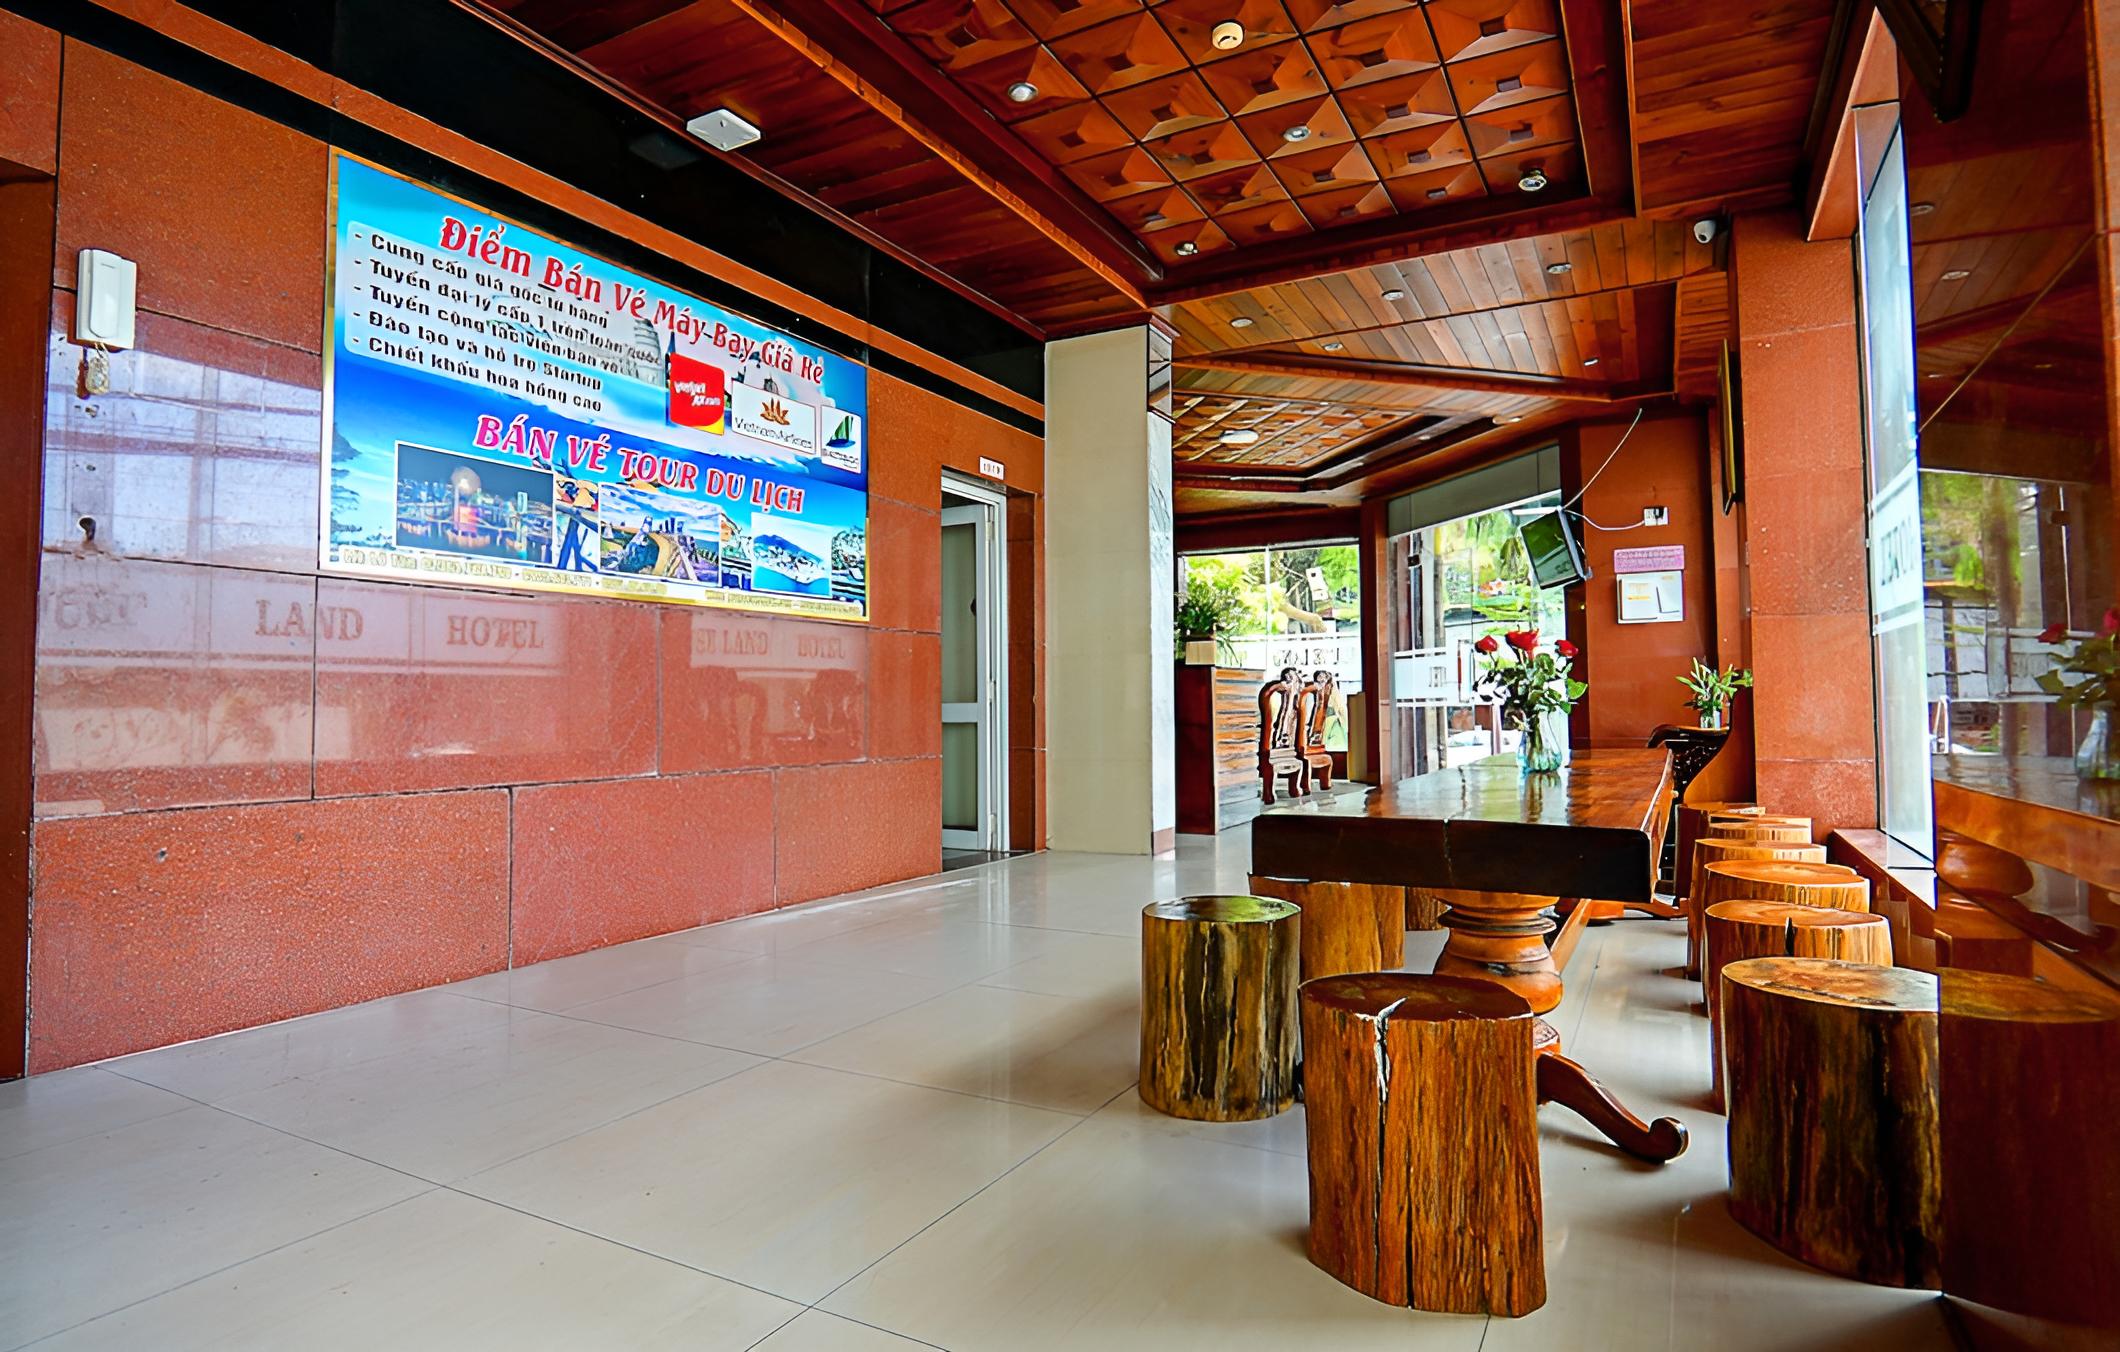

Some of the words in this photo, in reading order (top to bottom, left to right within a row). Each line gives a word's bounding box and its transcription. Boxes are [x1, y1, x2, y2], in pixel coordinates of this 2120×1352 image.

[371, 234, 424, 265] Cung
[440, 218, 530, 277] Điểm
[544, 256, 601, 303] Bán
[614, 283, 645, 318] Vé
[475, 415, 555, 459] BÁN
[568, 435, 609, 471] VÉ
[619, 450, 697, 490] TOUR
[707, 469, 743, 499] DU
[752, 480, 804, 512] LỊCH
[255, 599, 364, 641] LAND
[446, 615, 544, 649] HOTEL
